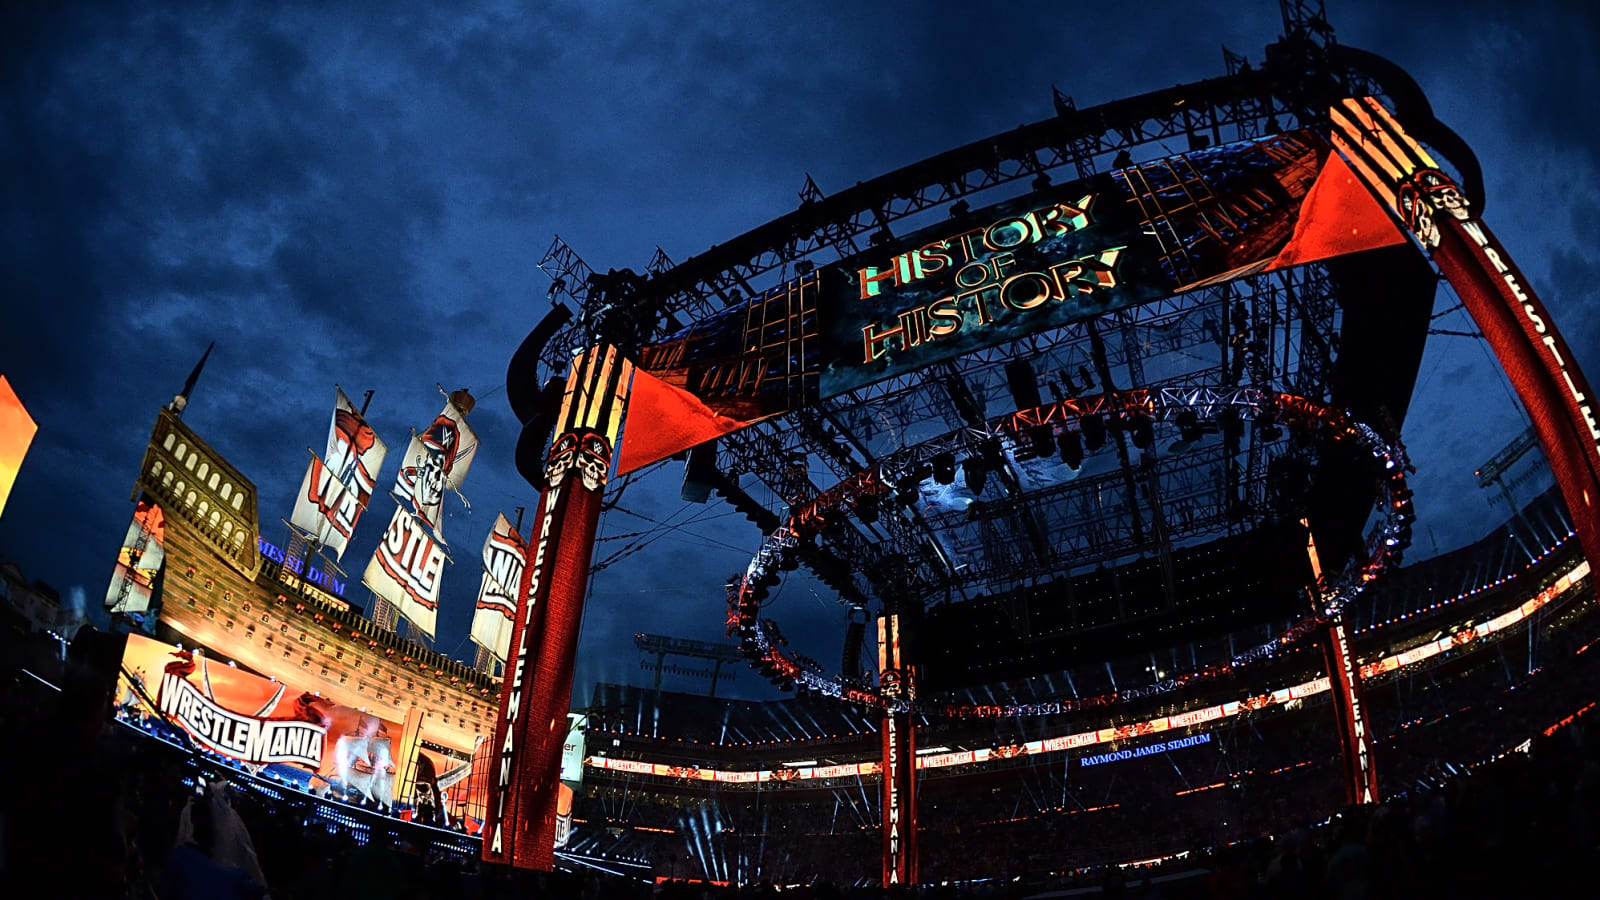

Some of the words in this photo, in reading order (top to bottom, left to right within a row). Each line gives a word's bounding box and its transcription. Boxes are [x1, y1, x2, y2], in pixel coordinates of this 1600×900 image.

[857, 193, 1099, 300] HISTORY
[955, 252, 1016, 288] OF
[862, 246, 1127, 364] HISTORY
[1462, 221, 1600, 457] WRESTLE
[286, 555, 346, 596] STDIUM
[491, 487, 561, 854] WRESTLEMANIA
[1081, 750, 1132, 767] RAYMOND
[1133, 742, 1166, 758] JAMES
[1167, 733, 1211, 751] STADIUM
